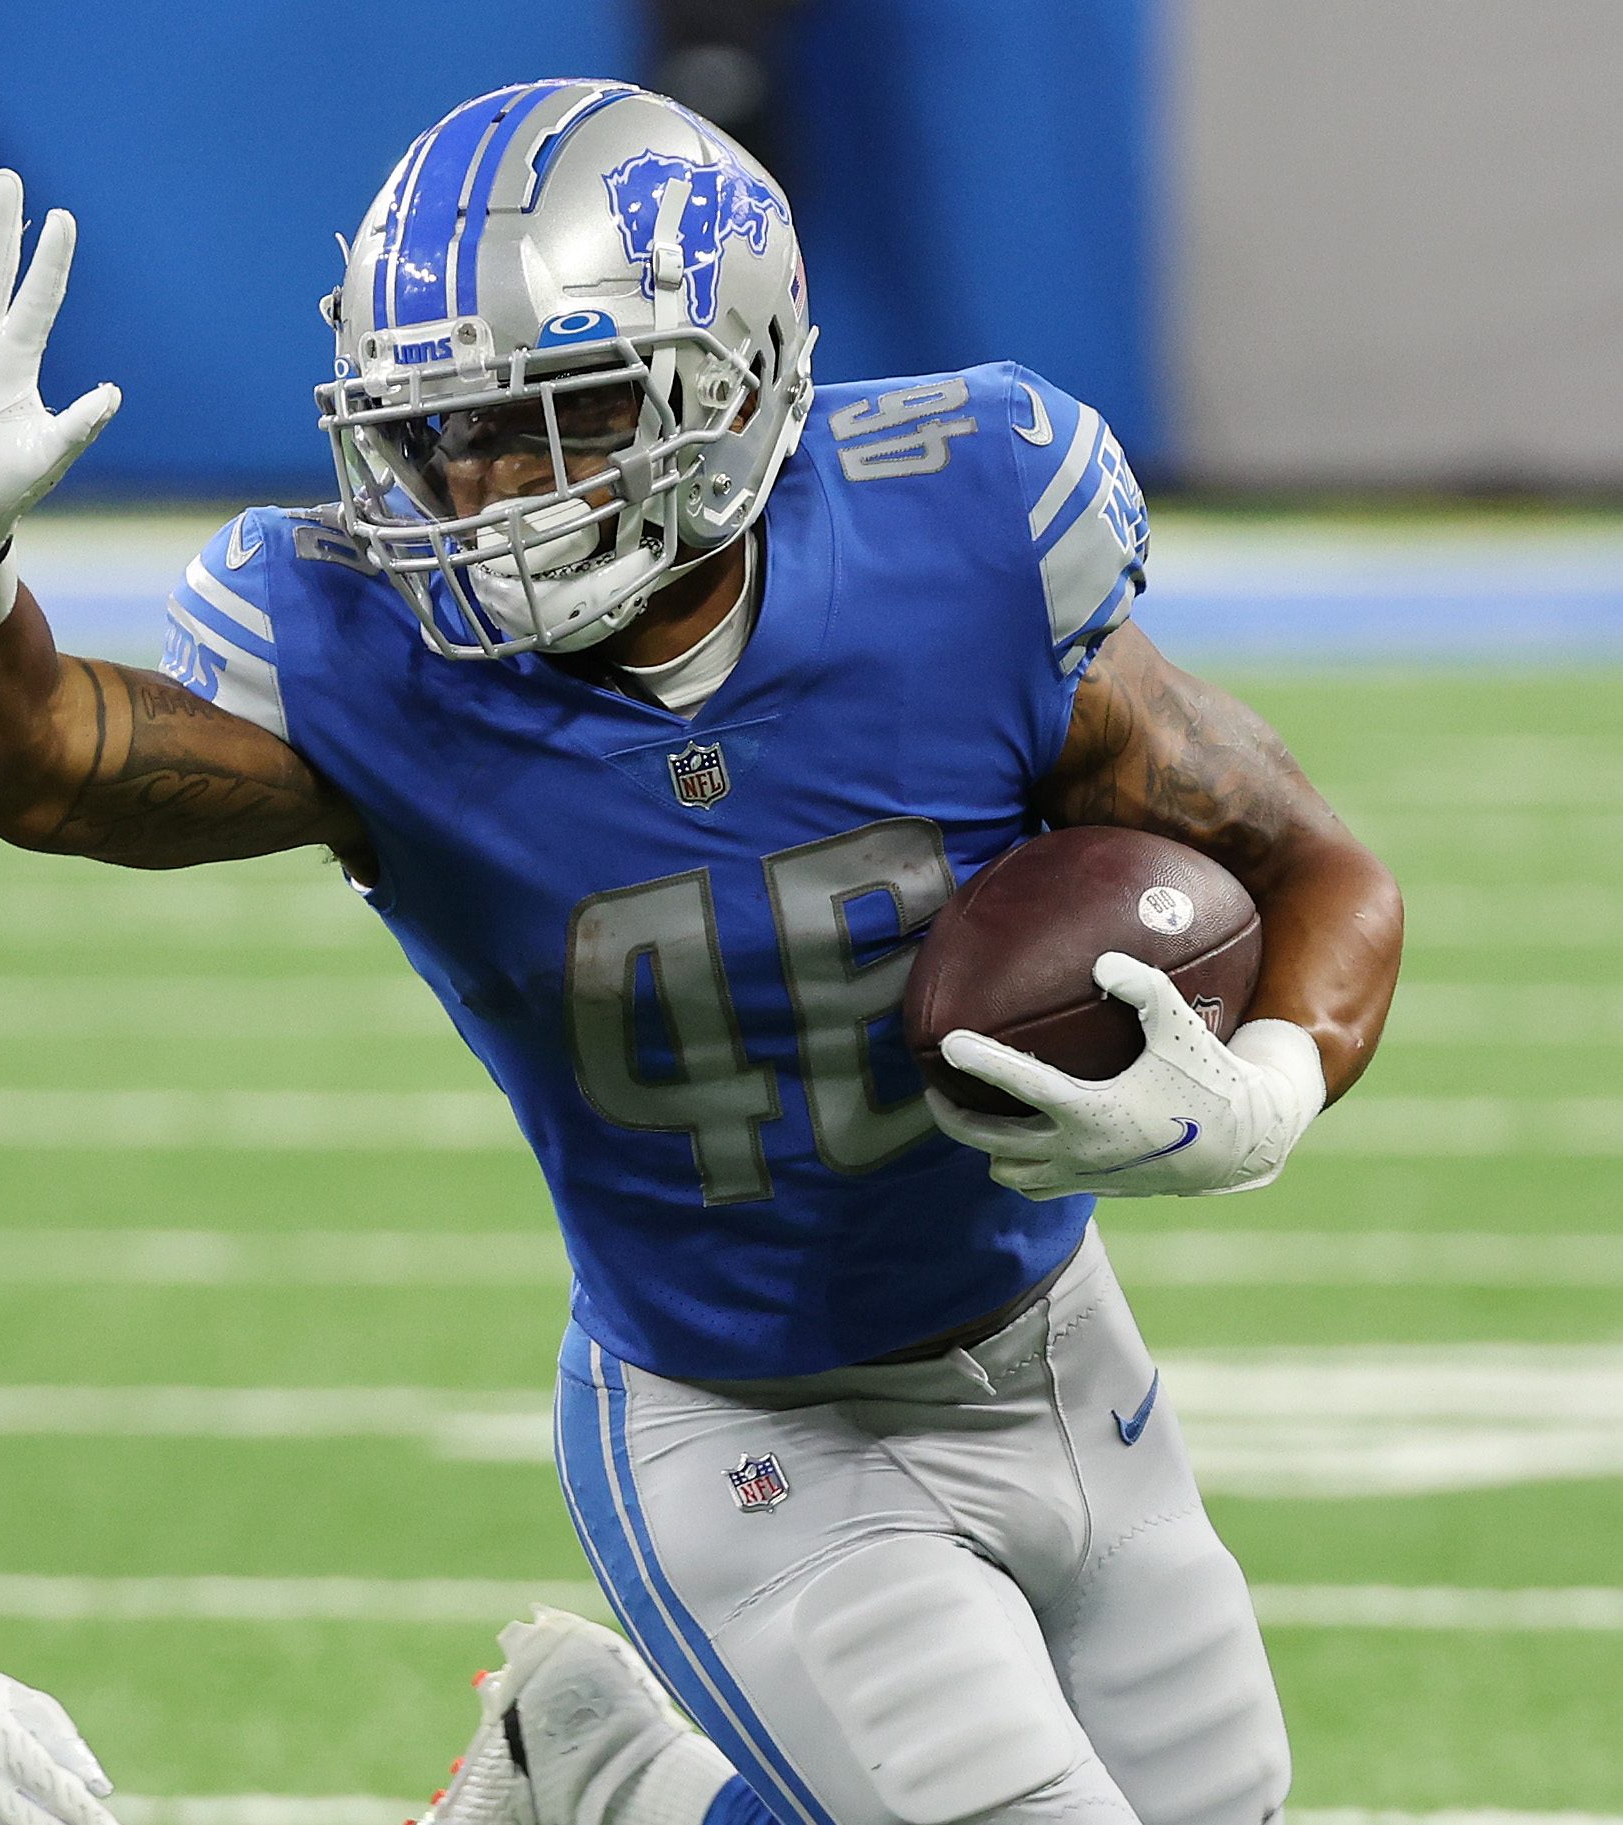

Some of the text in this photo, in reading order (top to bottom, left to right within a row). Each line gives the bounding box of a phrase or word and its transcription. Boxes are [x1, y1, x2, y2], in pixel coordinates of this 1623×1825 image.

[829, 376, 977, 482] 46
[682, 771, 721, 797] NFL
[565, 815, 955, 1208] 46
[740, 1475, 781, 1503] NFL
